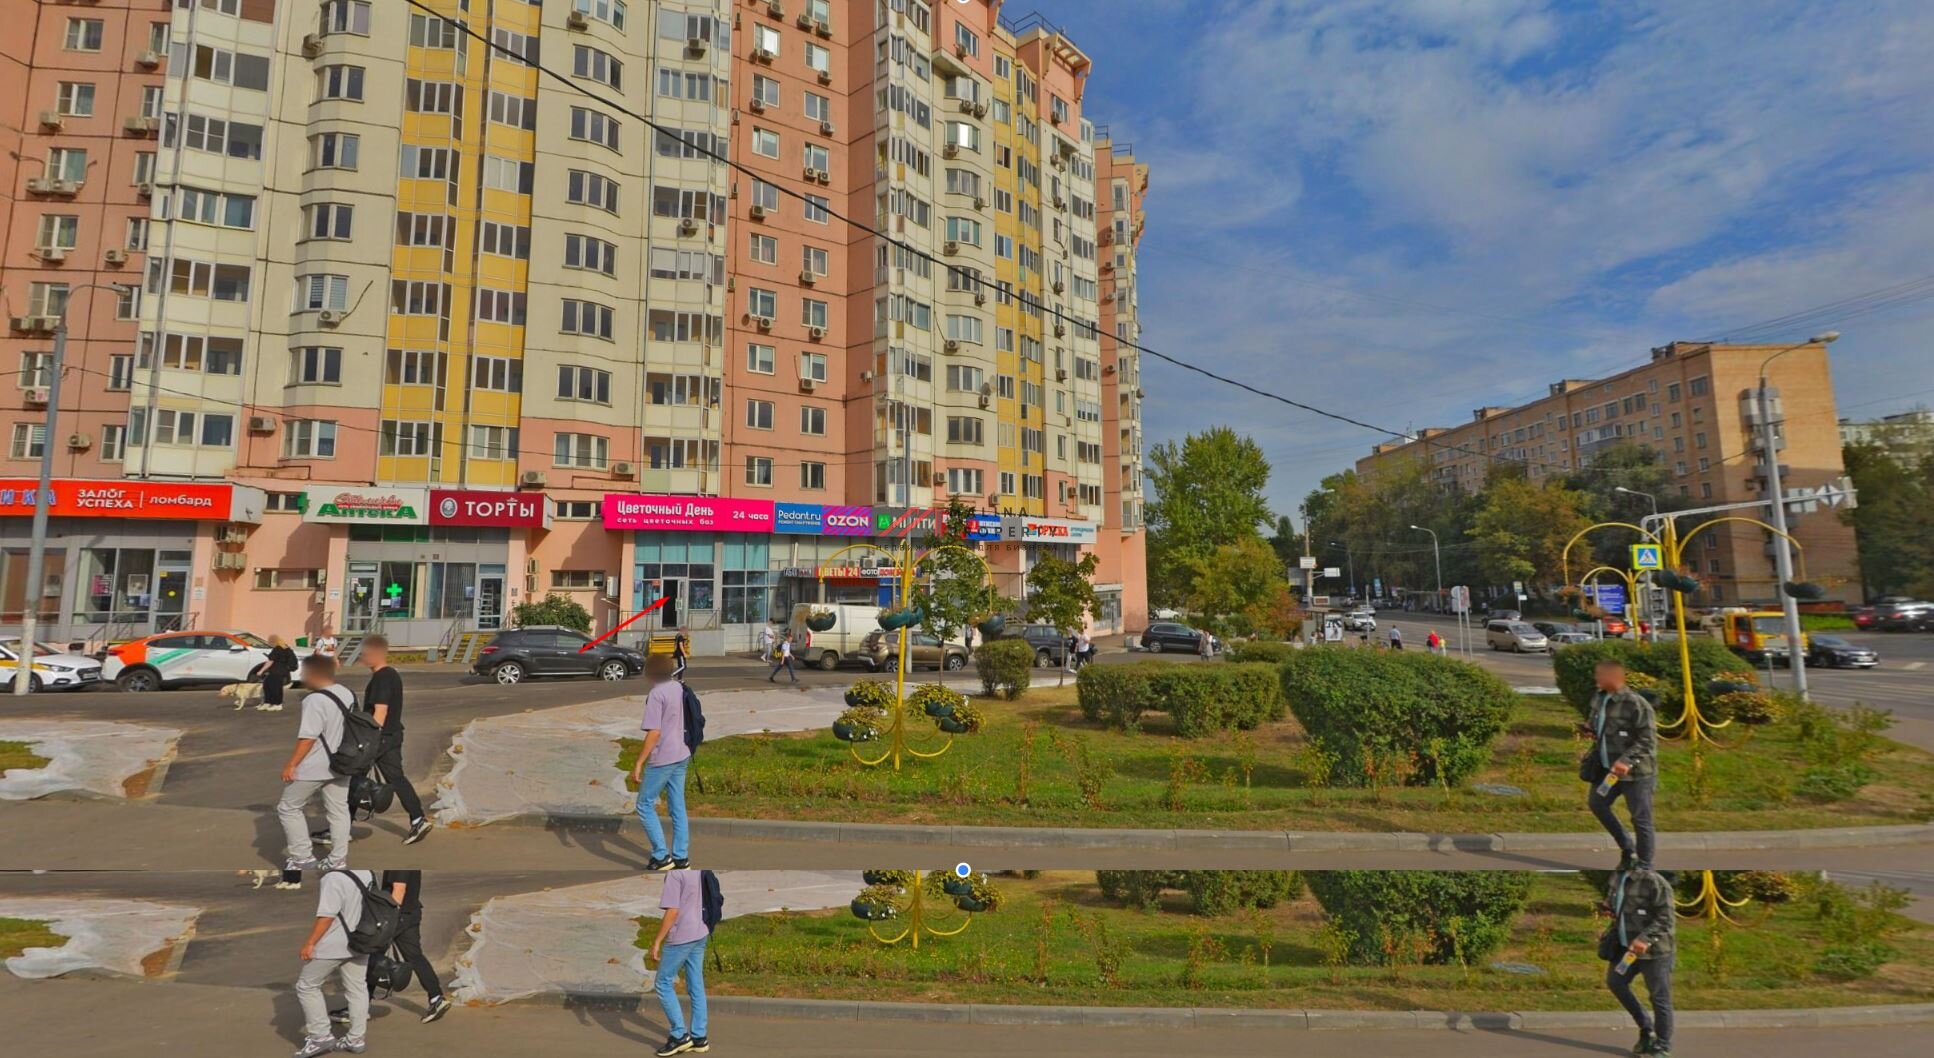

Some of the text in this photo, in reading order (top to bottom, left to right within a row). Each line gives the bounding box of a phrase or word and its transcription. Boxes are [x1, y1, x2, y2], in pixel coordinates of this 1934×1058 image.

[78, 489, 126, 499] ЗАЛОГ
[77, 498, 134, 509] УСПЕХА
[150, 495, 212, 507] ломбард
[465, 500, 535, 518] ТОРТЫ
[617, 501, 714, 517] Цветочный День
[643, 517, 693, 525] цветочных
[733, 510, 769, 521] 24 часа
[778, 510, 821, 521] Pedant.ru
[827, 515, 869, 527] OZON
[848, 567, 859, 577] 24
[861, 568, 878, 576] ФОТО
